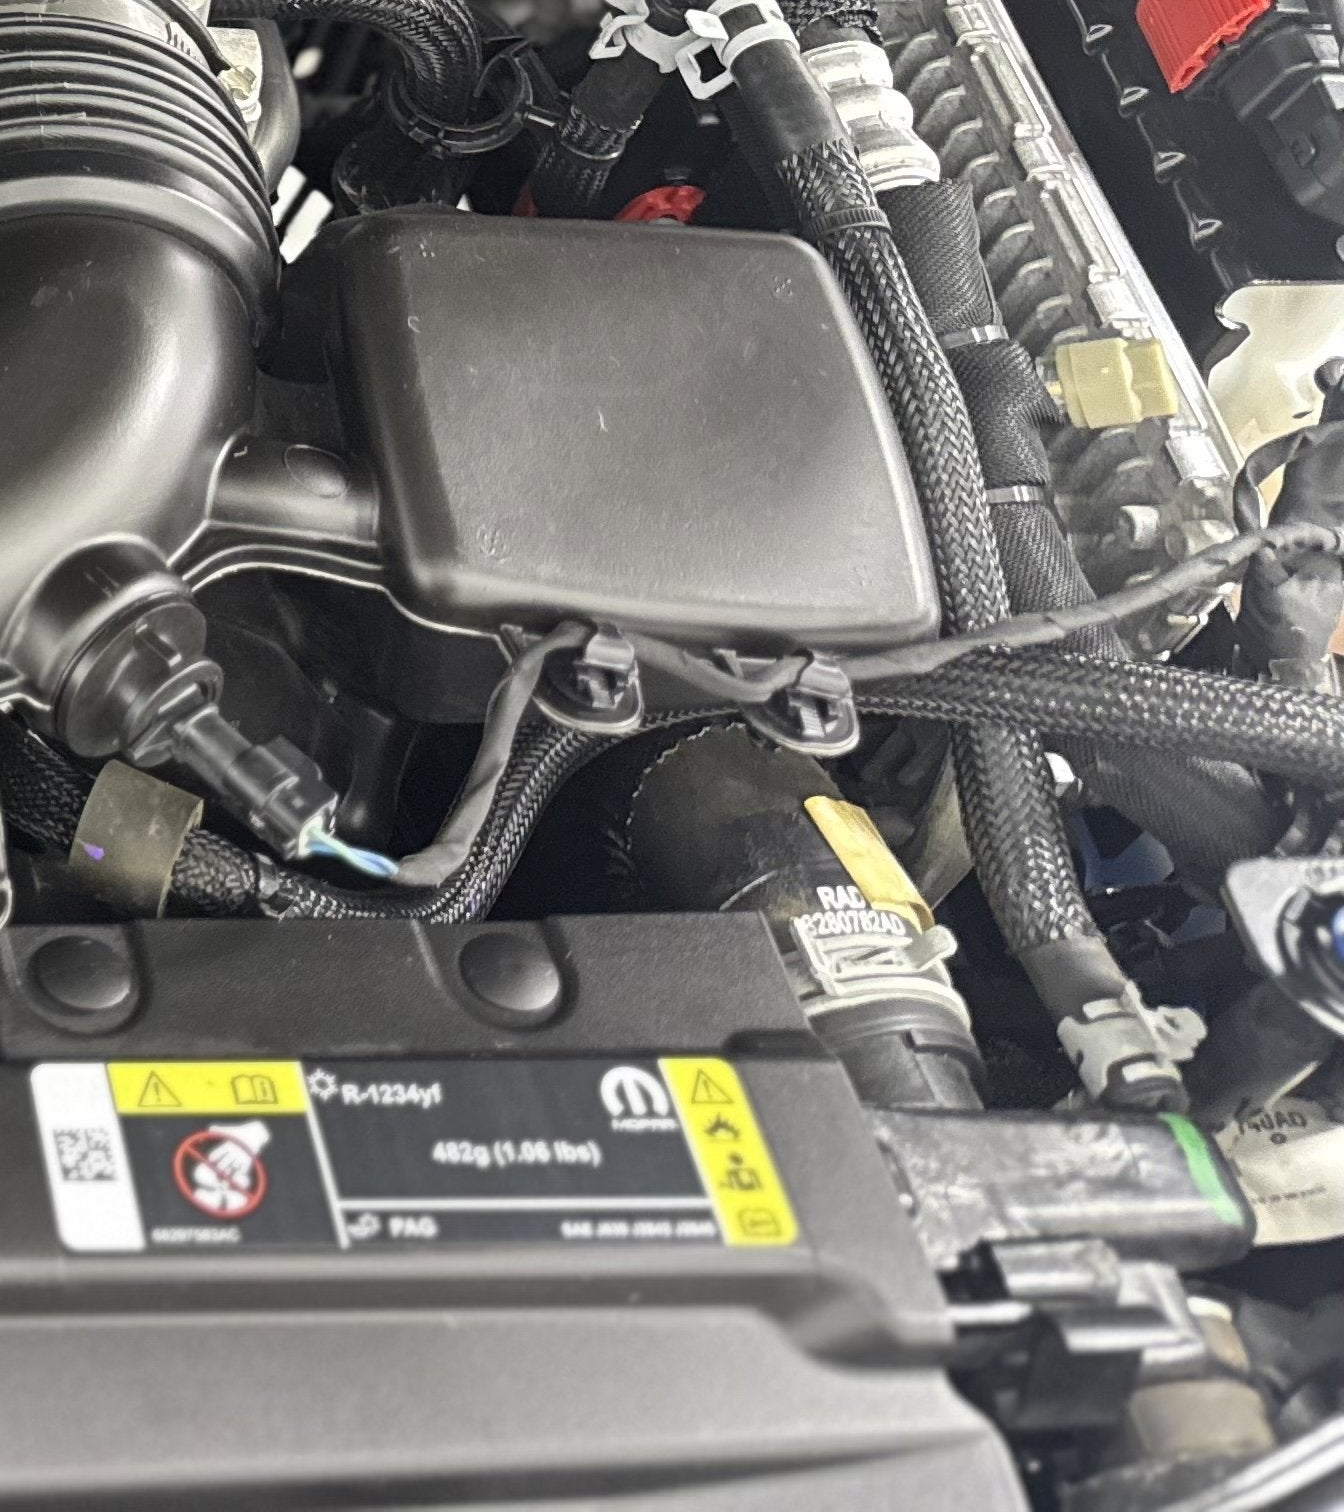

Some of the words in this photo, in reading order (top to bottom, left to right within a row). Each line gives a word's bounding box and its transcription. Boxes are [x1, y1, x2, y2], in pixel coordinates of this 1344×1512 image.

[816, 885, 867, 910] RAD
[340, 1082, 443, 1109] R-1234yf
[432, 1140, 491, 1169] 482g
[553, 1139, 603, 1168] lbs)
[388, 1215, 439, 1238] PAG
